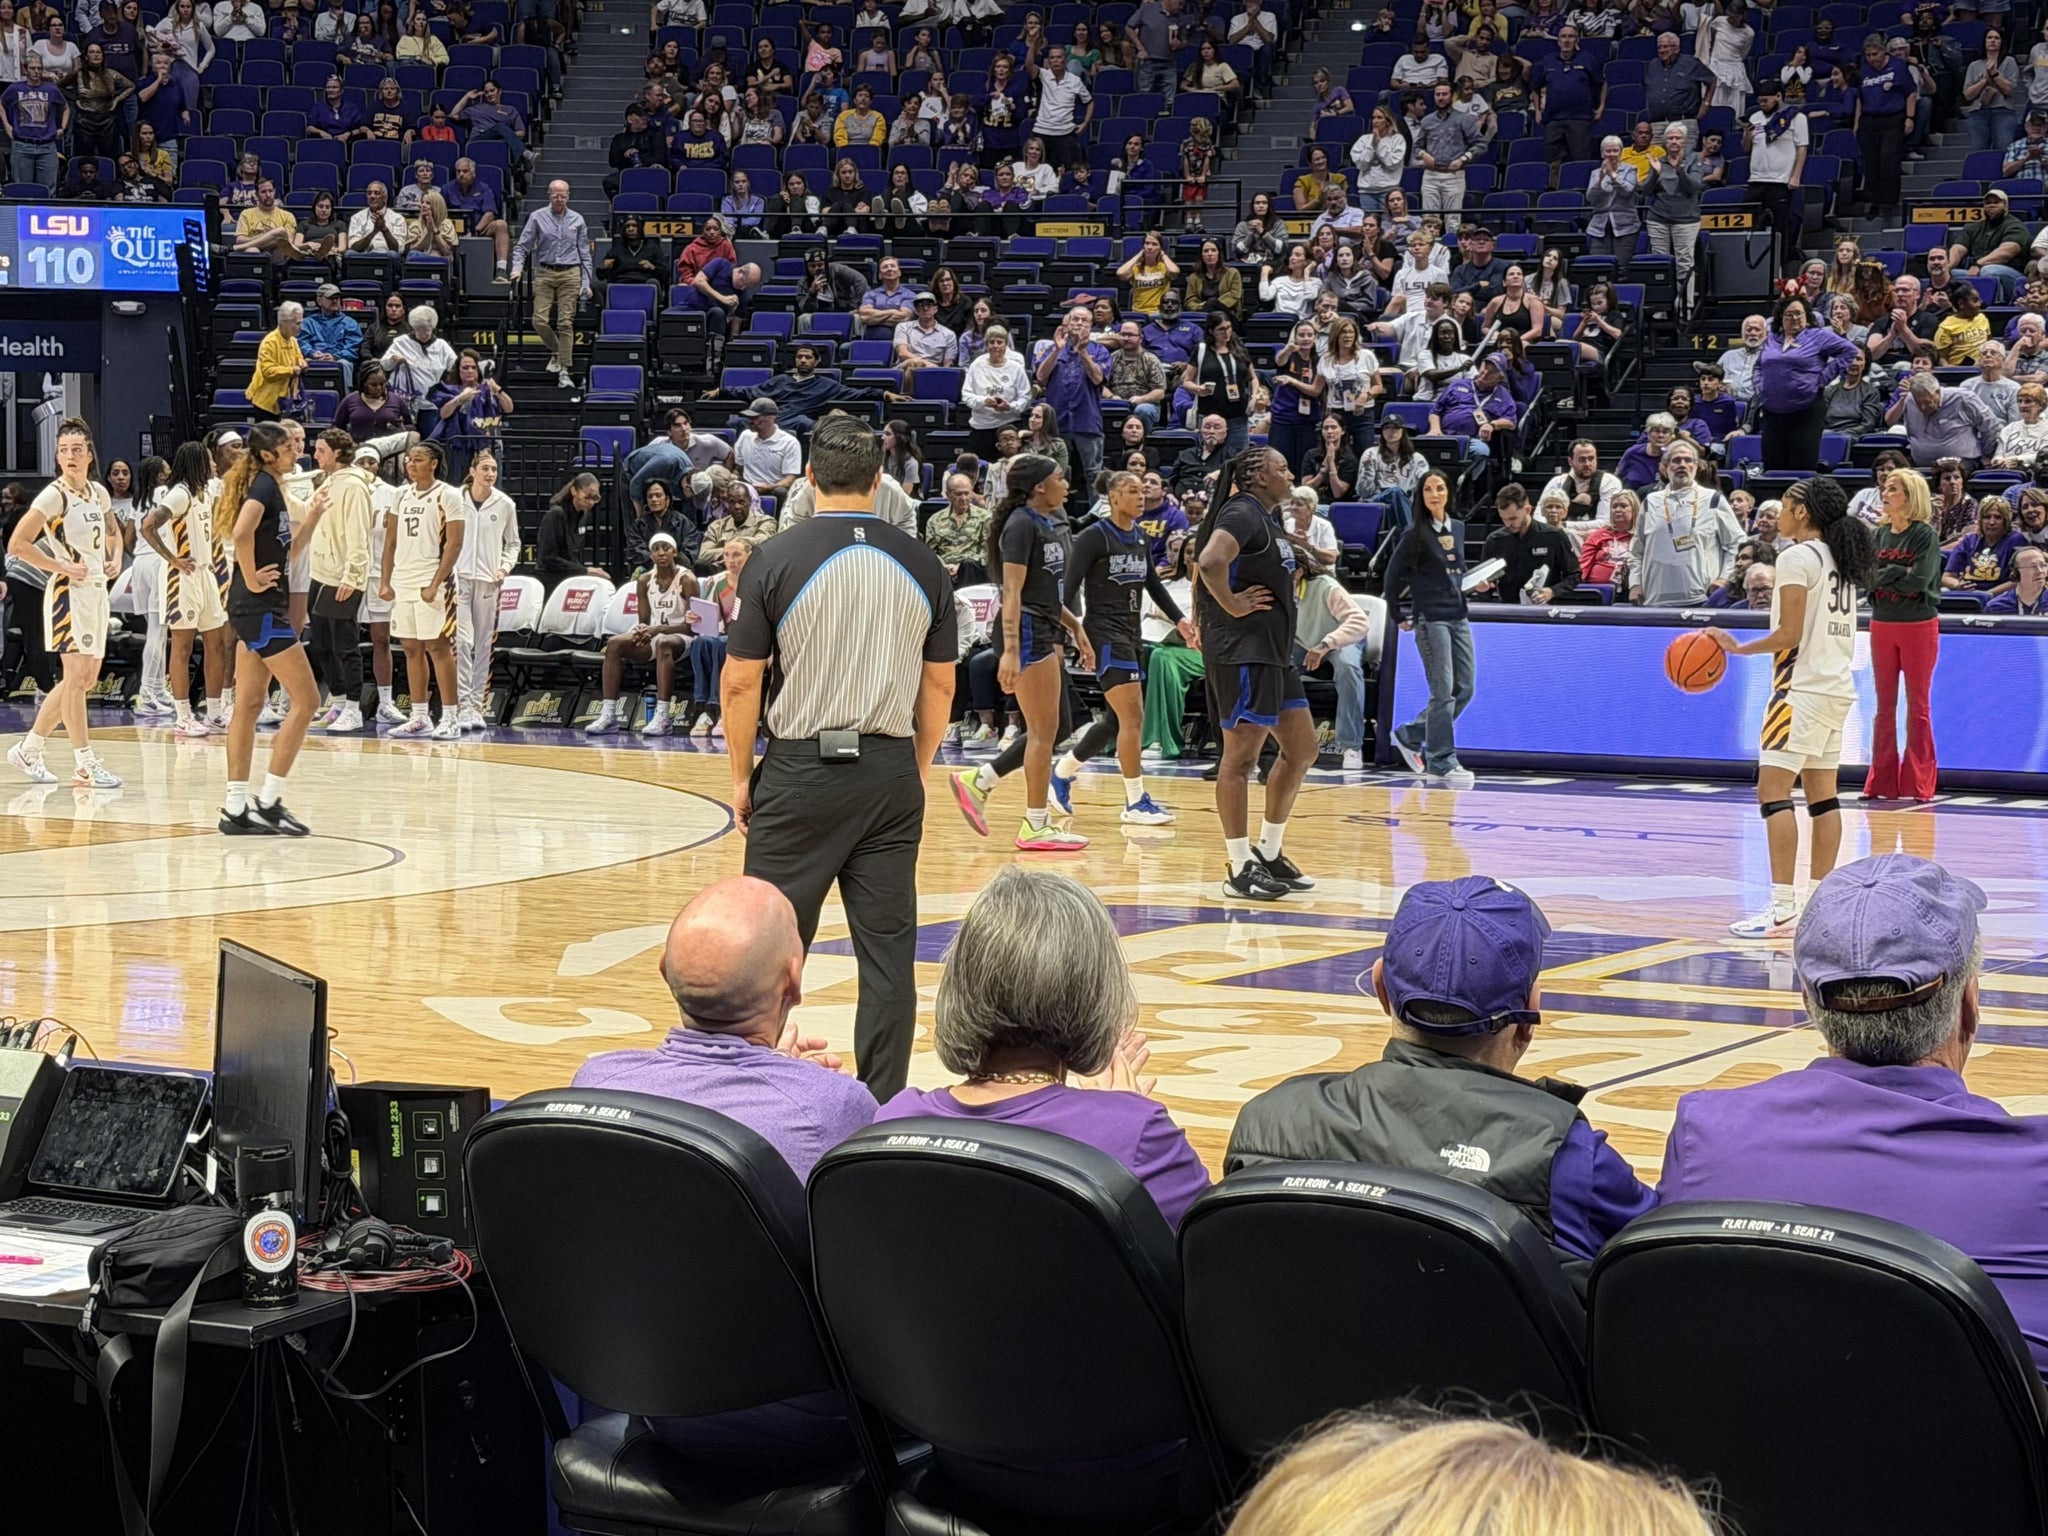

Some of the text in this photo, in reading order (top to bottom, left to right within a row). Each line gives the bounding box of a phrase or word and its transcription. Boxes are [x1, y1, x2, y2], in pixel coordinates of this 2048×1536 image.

[18, 91, 49, 101] LSU
[1710, 215, 1745, 227] 112
[1945, 209, 1983, 221] 113
[30, 215, 89, 236] LSU
[127, 226, 156, 239] THE
[652, 223, 686, 235] 112
[1078, 225, 1101, 236] 112
[1299, 223, 1312, 233] 11
[111, 239, 186, 267] QUE
[28, 247, 95, 284] 110
[1134, 277, 1165, 288] TIGERS
[1404, 281, 1429, 291] LSU
[472, 331, 495, 345] 111
[1691, 335, 1717, 350] 12
[84, 512, 102, 523] LSU
[198, 512, 211, 521] LSU
[403, 506, 425, 515] LSU
[203, 523, 209, 543] 6
[404, 517, 419, 537] 12
[93, 525, 101, 550] 2
[1964, 565, 2001, 582] LSU
[1827, 569, 1851, 616] 30
[653, 600, 673, 609] LSU
[660, 612, 669, 626] 4
[389, 1100, 399, 1122] 233
[563, 1103, 585, 1113] ROW
[587, 1105, 597, 1115] A
[597, 1107, 620, 1118] SEAT
[618, 1110, 632, 1120] 24
[391, 1124, 402, 1158] Model
[906, 1136, 930, 1146] ROW
[933, 1138, 943, 1147] A
[943, 1139, 967, 1150] SEAT
[965, 1142, 980, 1152] 23
[1440, 1148, 1475, 1163] NORTH
[1457, 1143, 1478, 1155] THE
[1447, 1159, 1476, 1170] FACE
[1305, 1178, 1329, 1189] ROW
[1334, 1181, 1343, 1191] A
[1345, 1182, 1371, 1194] SEAT
[1370, 1186, 1387, 1198] 22
[1747, 1220, 1775, 1231] ROW
[1781, 1223, 1791, 1234] A
[1792, 1225, 1822, 1238] SEAT
[1820, 1230, 1836, 1241] 21
